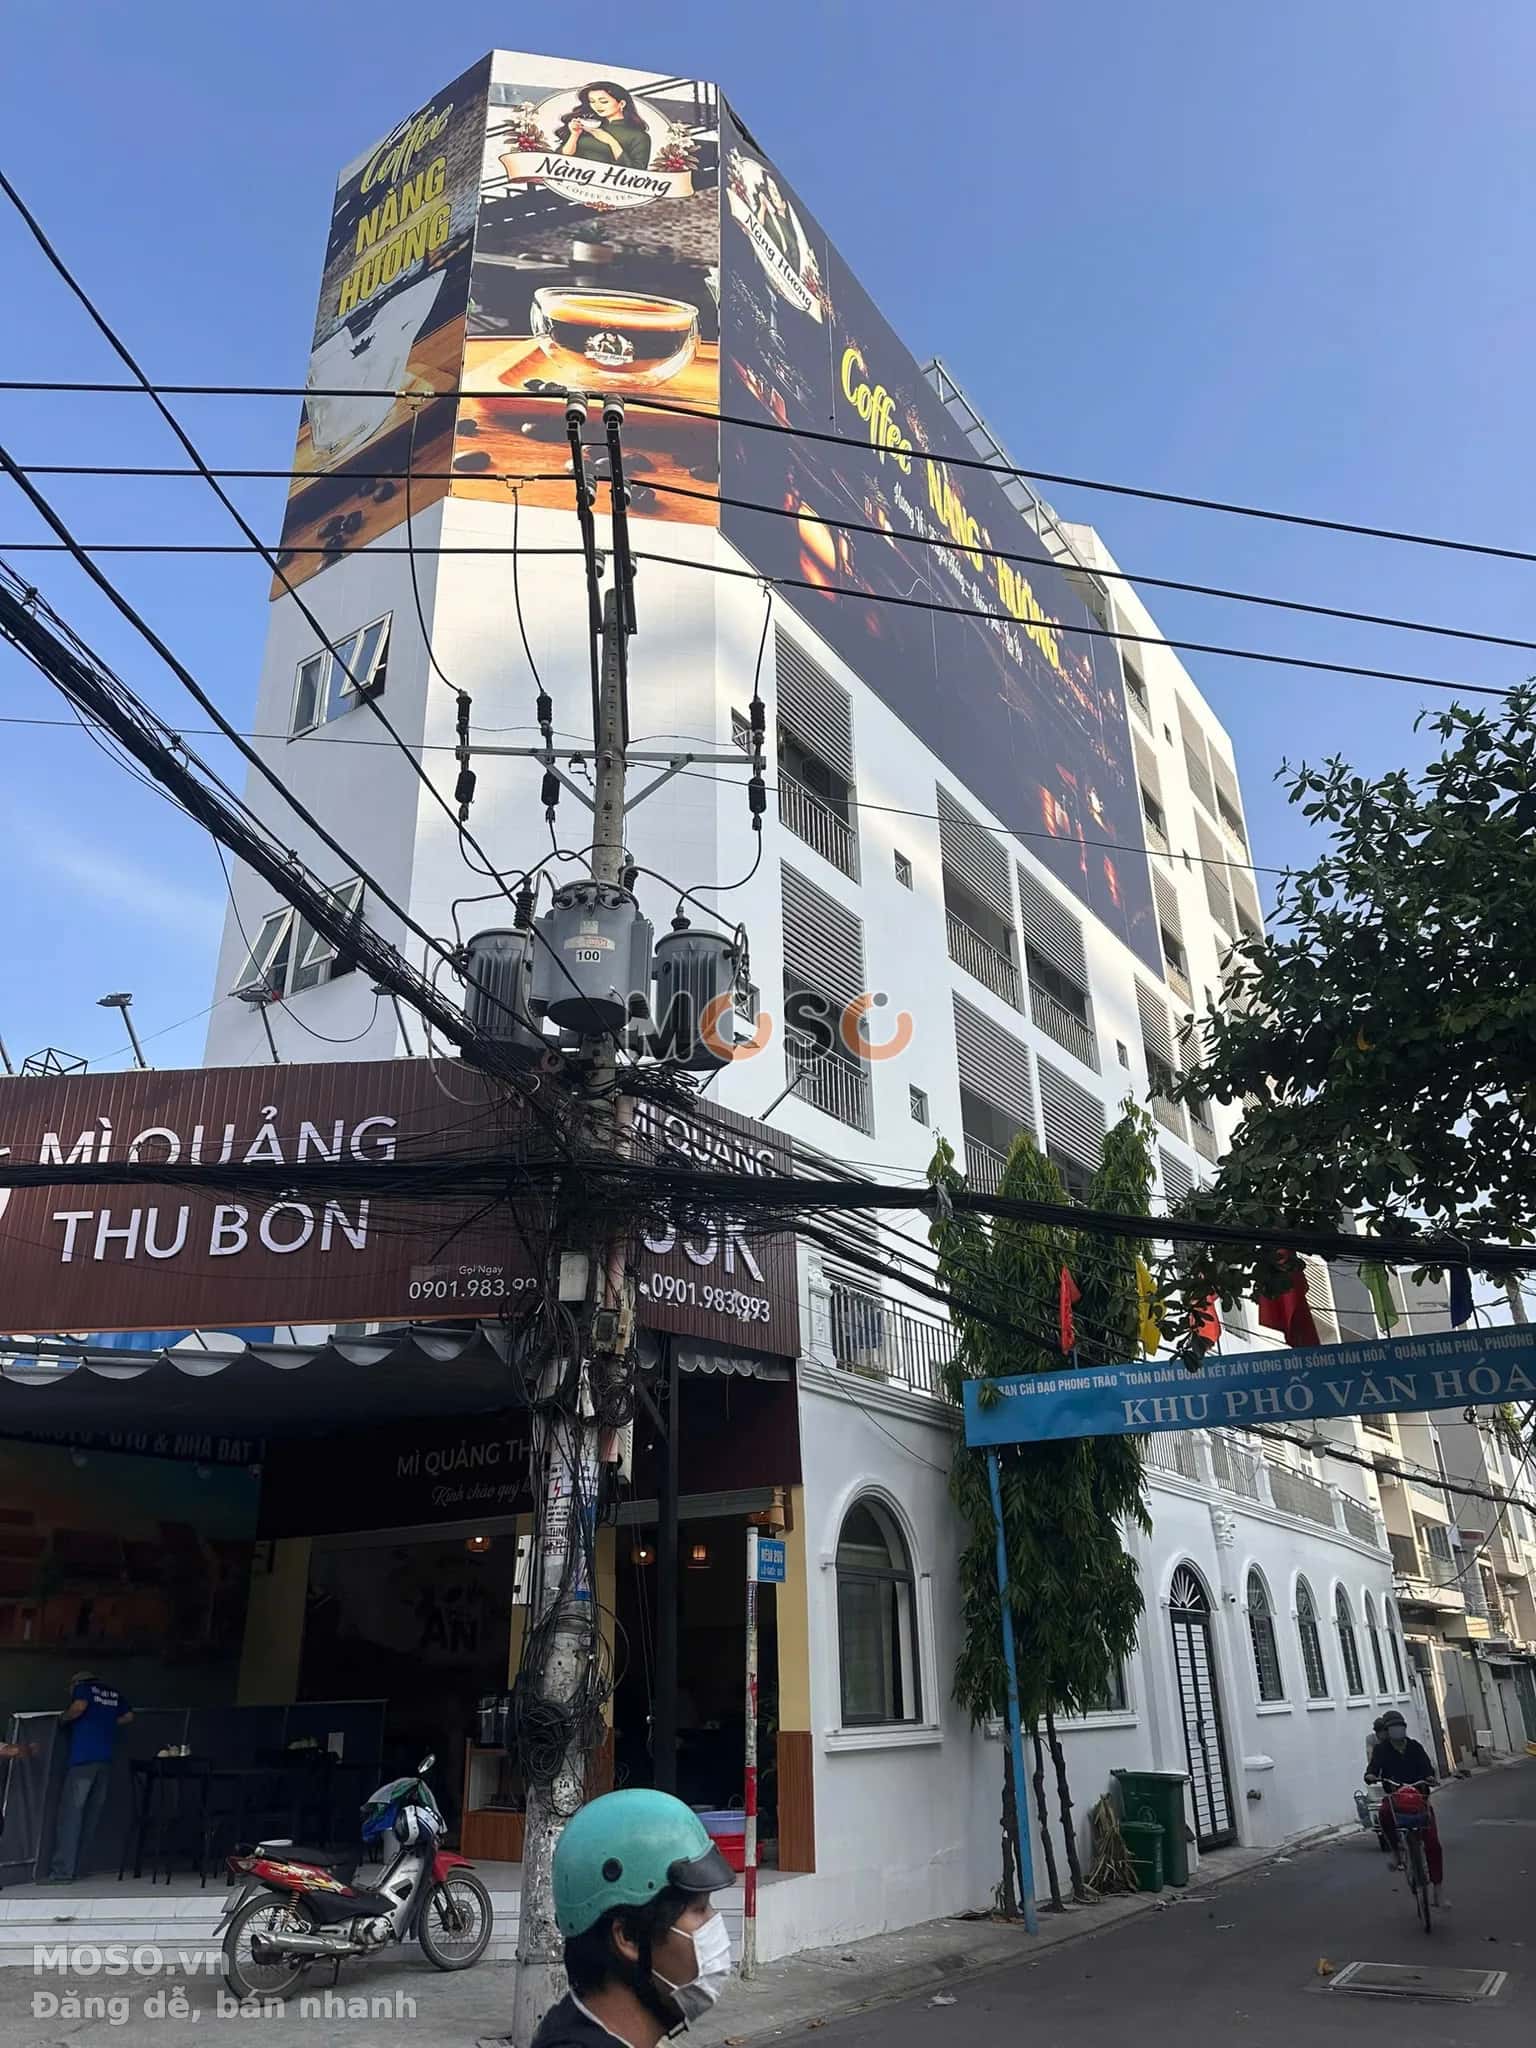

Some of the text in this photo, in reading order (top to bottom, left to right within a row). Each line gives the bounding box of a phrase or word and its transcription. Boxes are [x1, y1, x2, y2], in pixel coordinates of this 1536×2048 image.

[360, 103, 454, 194] Coffee
[535, 156, 672, 198] Nàng Hương
[355, 156, 447, 256] NÀNG
[337, 203, 452, 317] HƯƠNG
[841, 348, 913, 475] Coffee
[577, 950, 600, 961] 100
[38, 1117, 113, 1166] MÌ
[53, 1206, 190, 1262] THU
[408, 1277, 538, 1299] 0901.983.9
[652, 1273, 770, 1322] 0901.983993
[1058, 1378, 1090, 1392] PHONG
[1121, 1357, 1536, 1427] KHU PHỐ VĂN HÓA
[506, 1438, 530, 1462] TH
